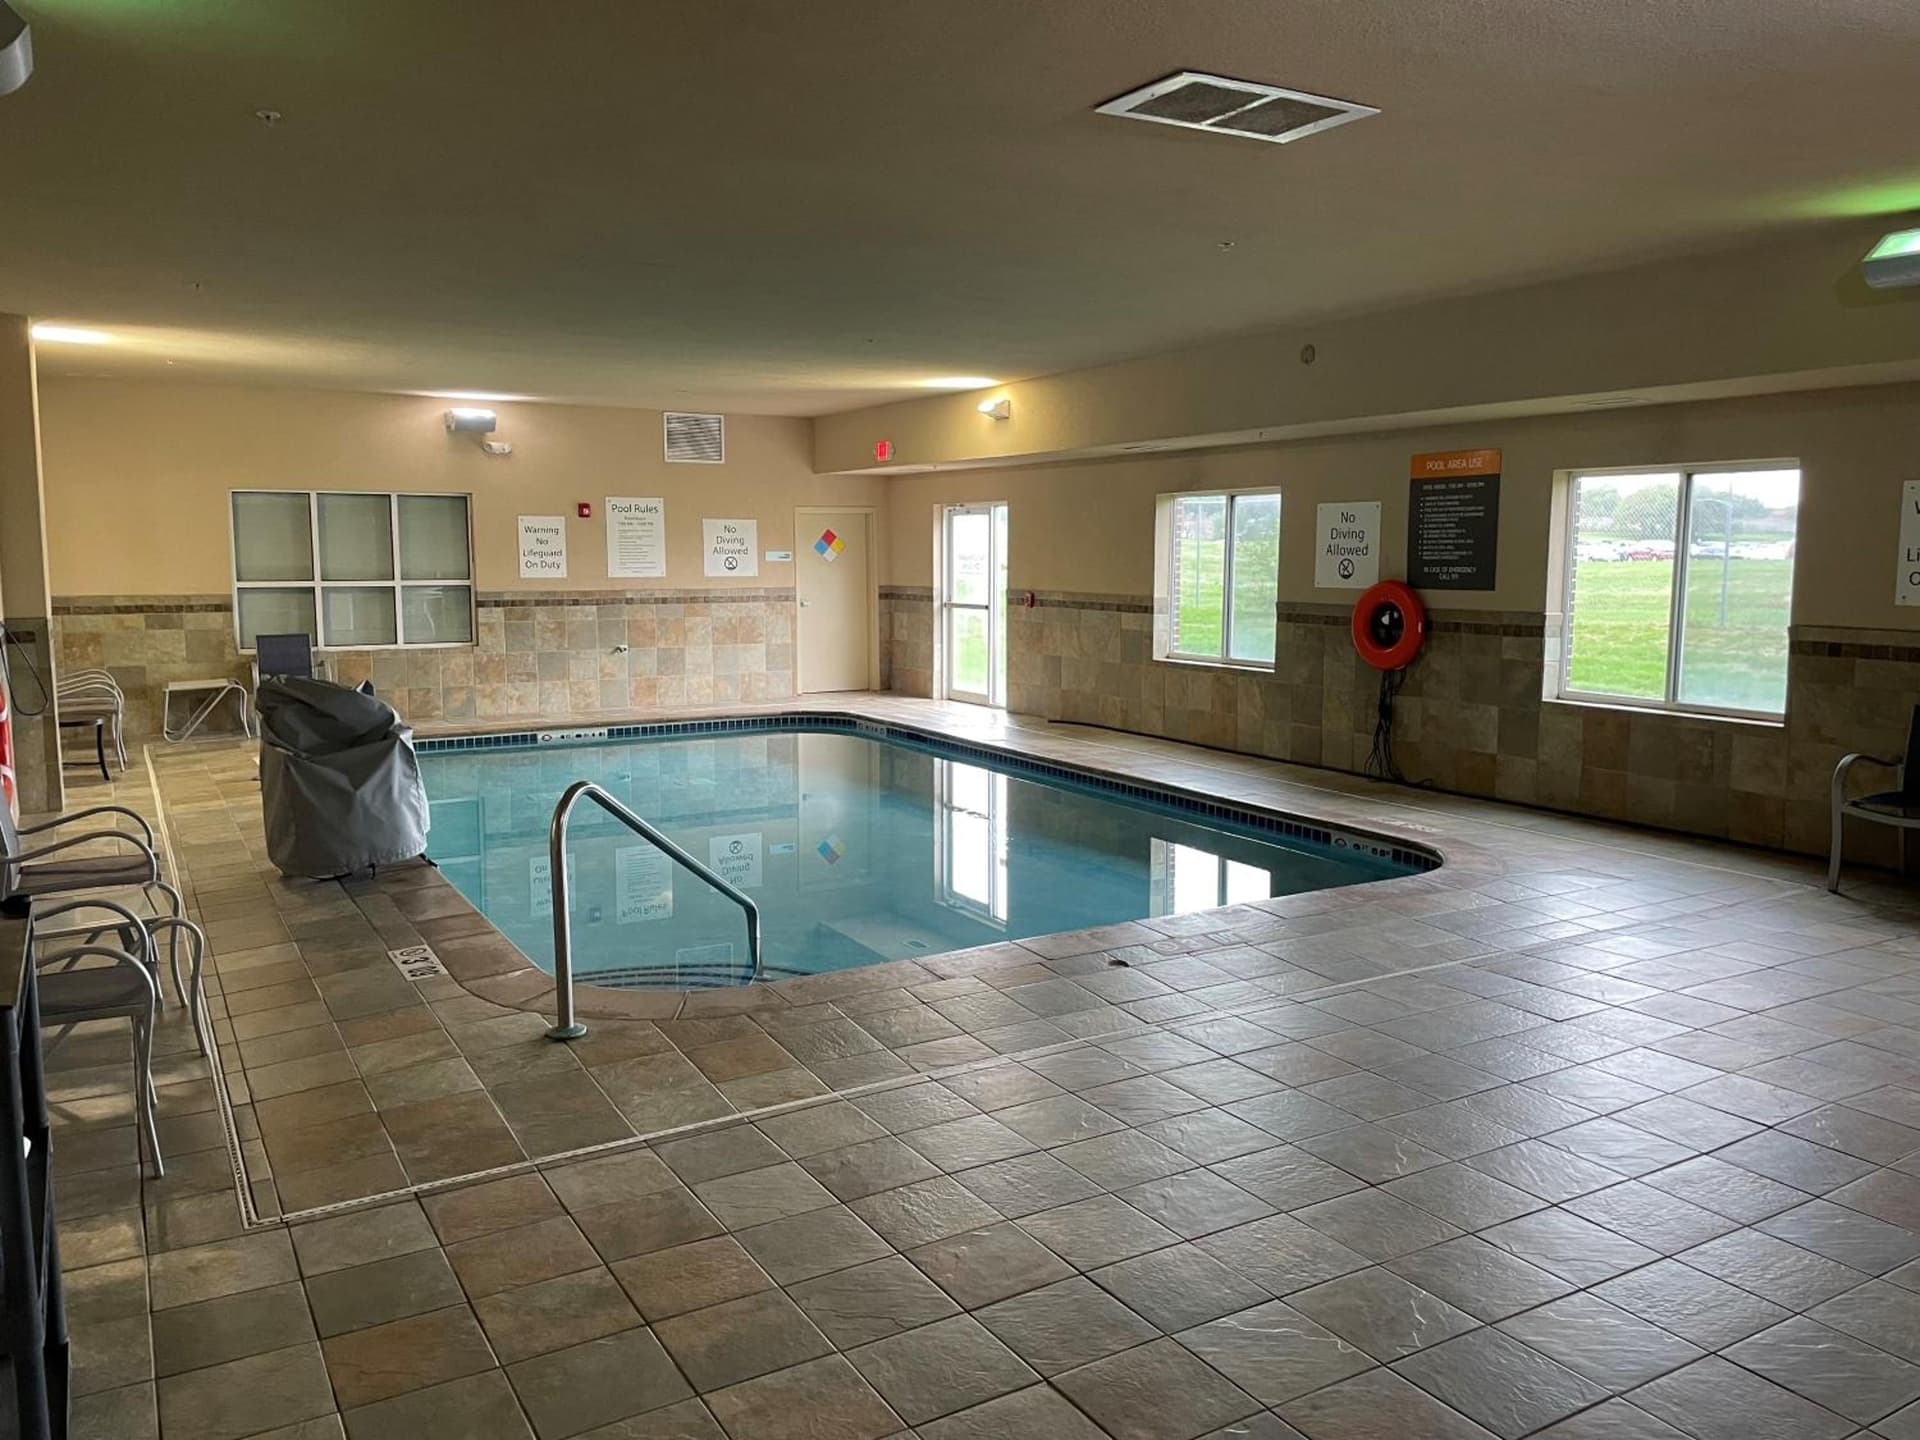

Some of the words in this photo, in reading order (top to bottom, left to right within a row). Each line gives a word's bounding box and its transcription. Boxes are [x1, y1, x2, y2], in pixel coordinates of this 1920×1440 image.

[611, 503, 632, 513] Pool
[634, 503, 659, 514] Rules
[1341, 511, 1356, 523] No
[524, 526, 559, 536] Warning
[723, 524, 737, 534] No
[716, 535, 745, 546] Diving
[1331, 527, 1365, 543] Diving
[523, 548, 562, 558] Lifeguard
[712, 546, 749, 556] Allowed
[1326, 543, 1369, 557] Allowed
[525, 559, 539, 569] On
[540, 559, 561, 570] Duty
